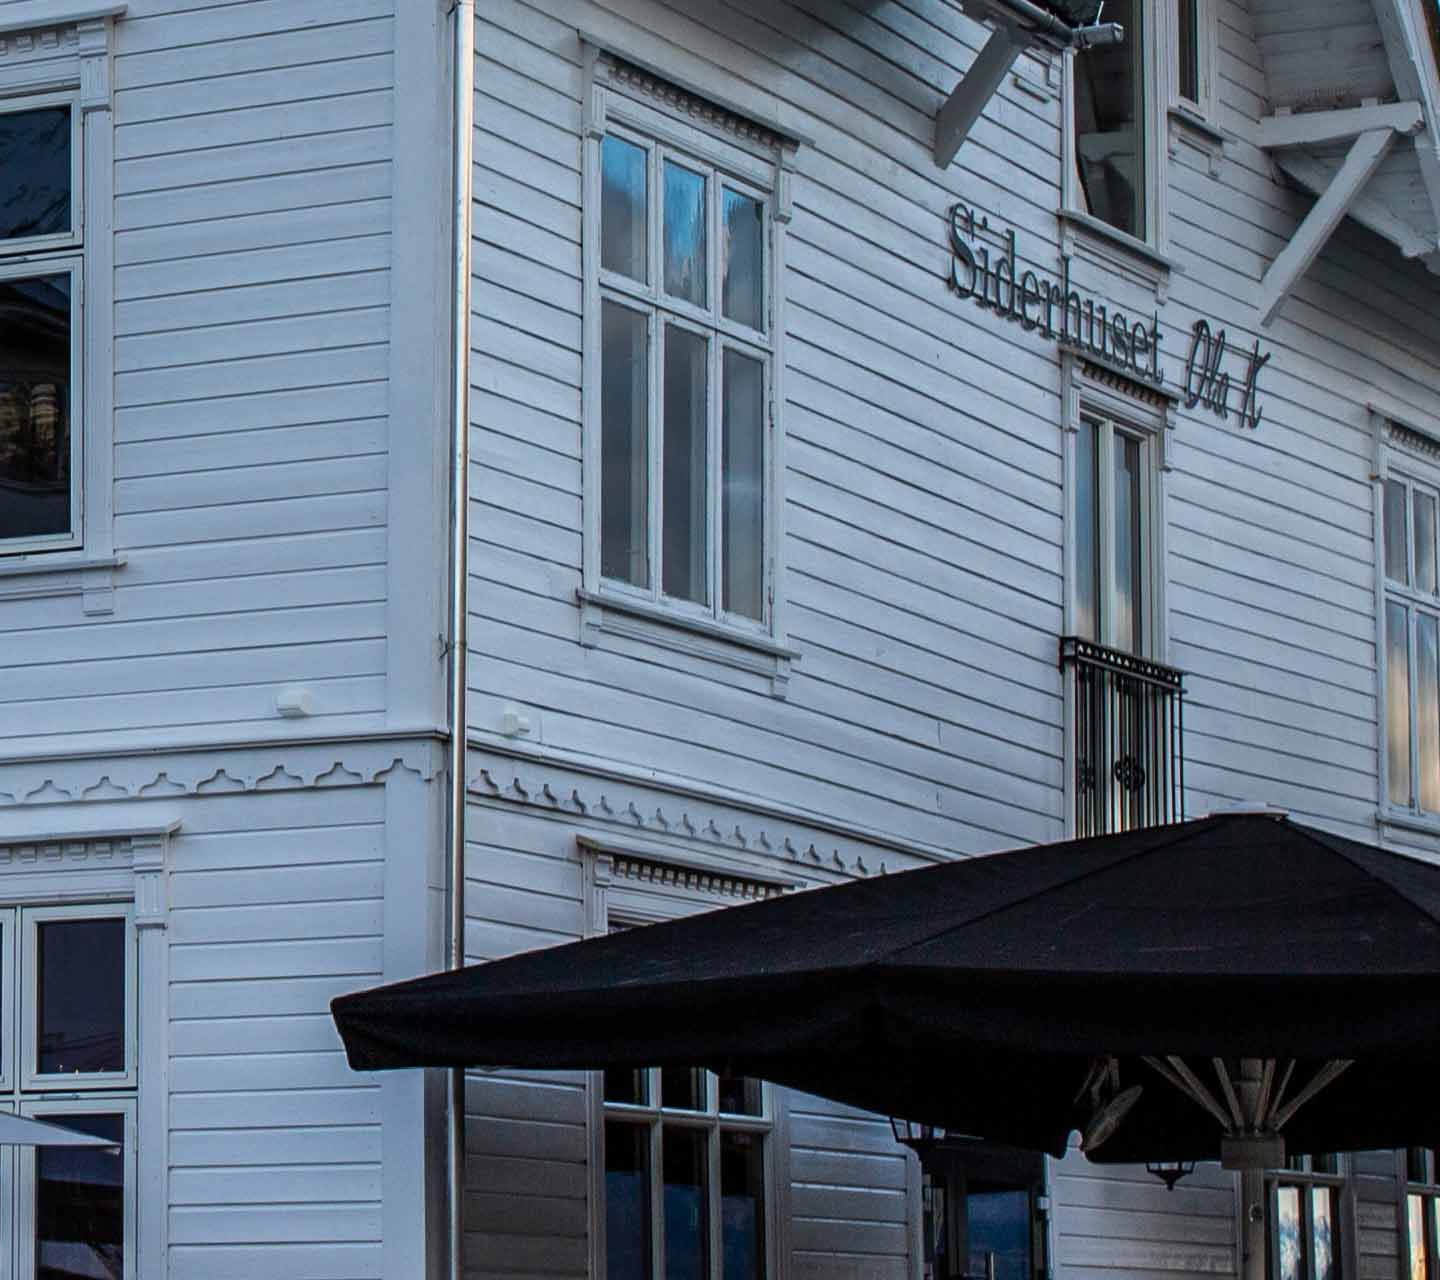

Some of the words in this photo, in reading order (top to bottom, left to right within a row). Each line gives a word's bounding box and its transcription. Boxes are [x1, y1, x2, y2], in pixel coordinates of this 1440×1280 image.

[946, 202, 1165, 385] Siderhuset
[1184, 319, 1230, 420] Ola
[1238, 338, 1271, 429] K
